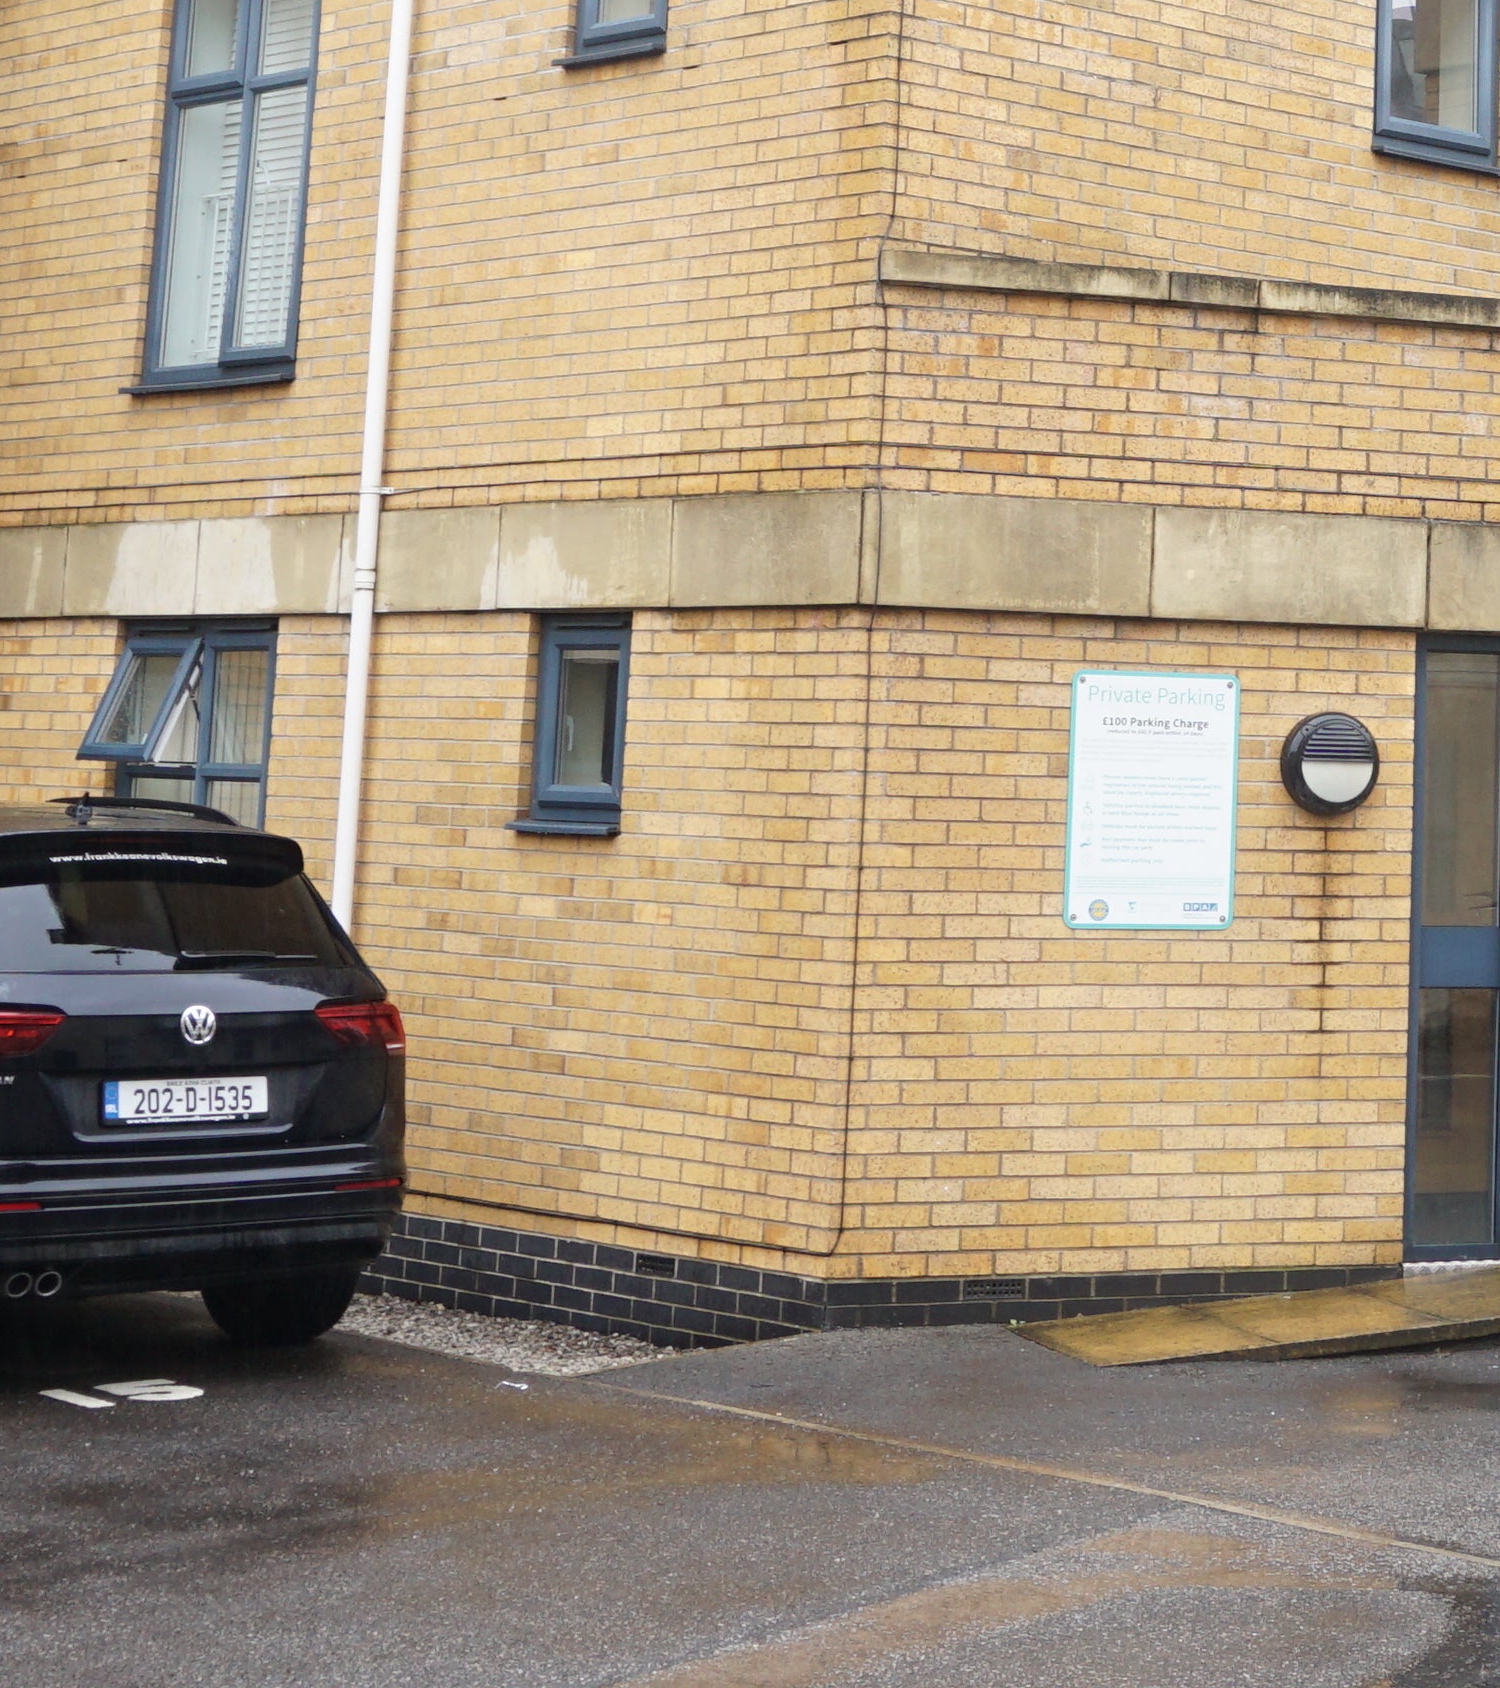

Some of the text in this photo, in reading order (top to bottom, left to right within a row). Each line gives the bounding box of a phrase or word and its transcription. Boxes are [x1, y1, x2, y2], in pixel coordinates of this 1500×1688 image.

[1088, 685, 1226, 712] Private Parking
[1102, 716, 1209, 731] £100 Parking Charge
[133, 1085, 253, 1114] 202-D-1535
[40, 1378, 204, 1409] 15
